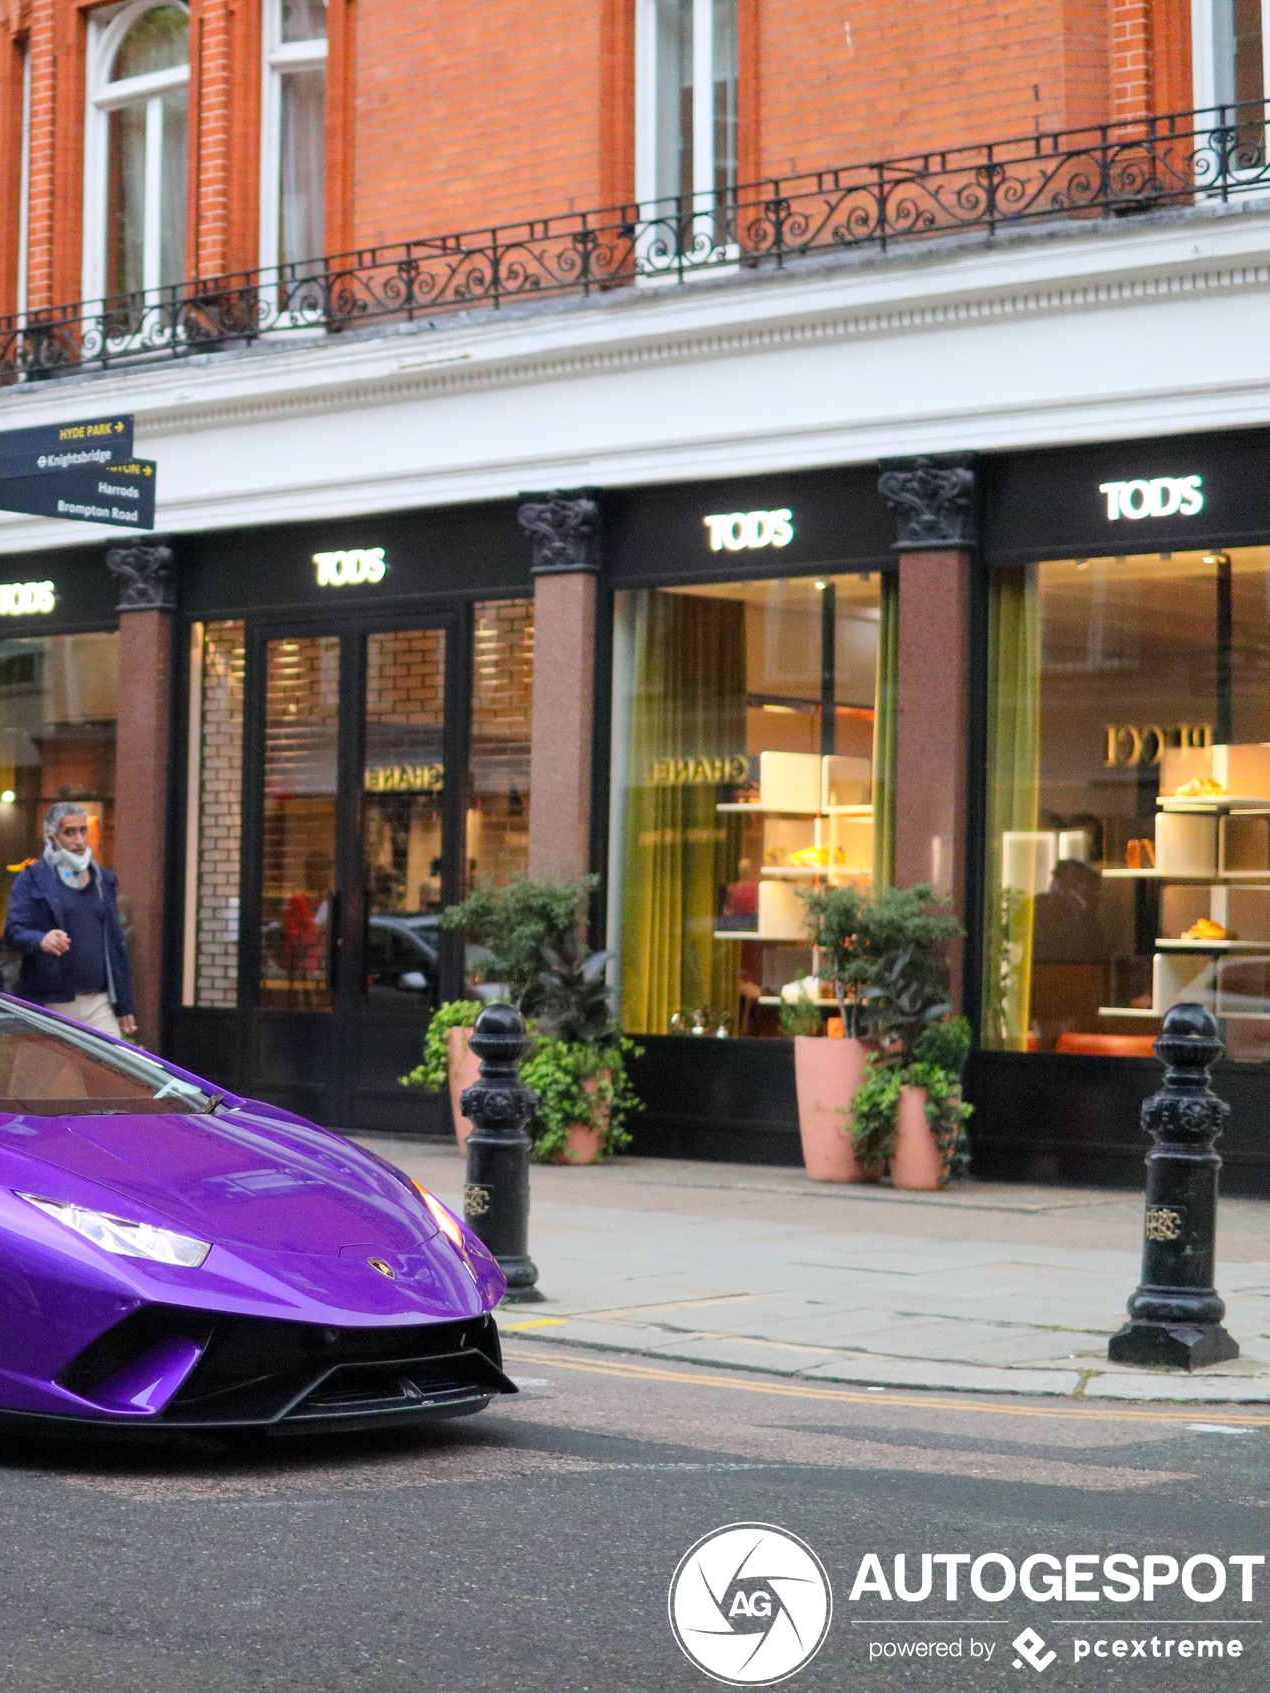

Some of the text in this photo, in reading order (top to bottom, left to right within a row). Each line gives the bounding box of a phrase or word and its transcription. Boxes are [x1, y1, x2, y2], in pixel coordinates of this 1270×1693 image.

[59, 423, 112, 440] HYDE PARK
[48, 449, 111, 467] Knightsbridge
[98, 482, 139, 498] Harrods
[57, 500, 138, 521] Brompton Road
